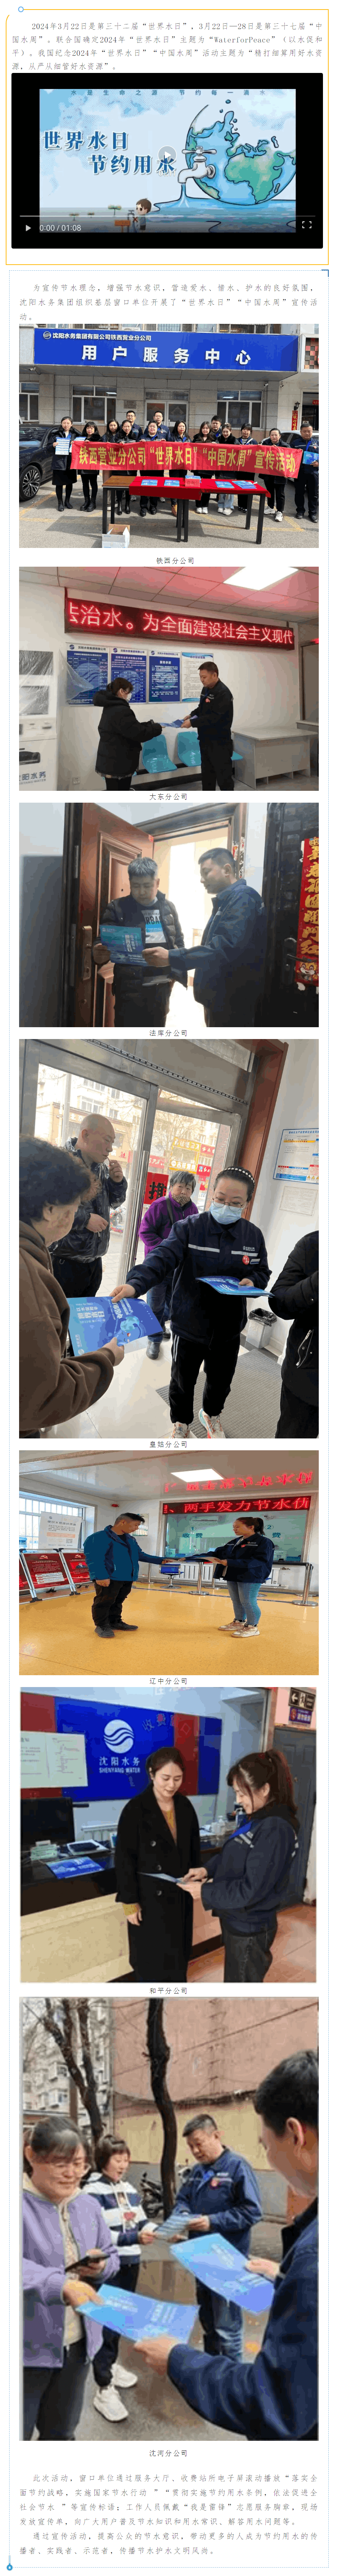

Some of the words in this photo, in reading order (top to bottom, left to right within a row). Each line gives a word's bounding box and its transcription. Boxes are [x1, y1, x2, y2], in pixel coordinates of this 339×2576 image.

[52, 332, 152, 341] 沈阳水务集团有限公司铁西营业分公司
[81, 345, 251, 365] 用户服务中心
[99, 1756, 140, 1766] 沈阳水务
